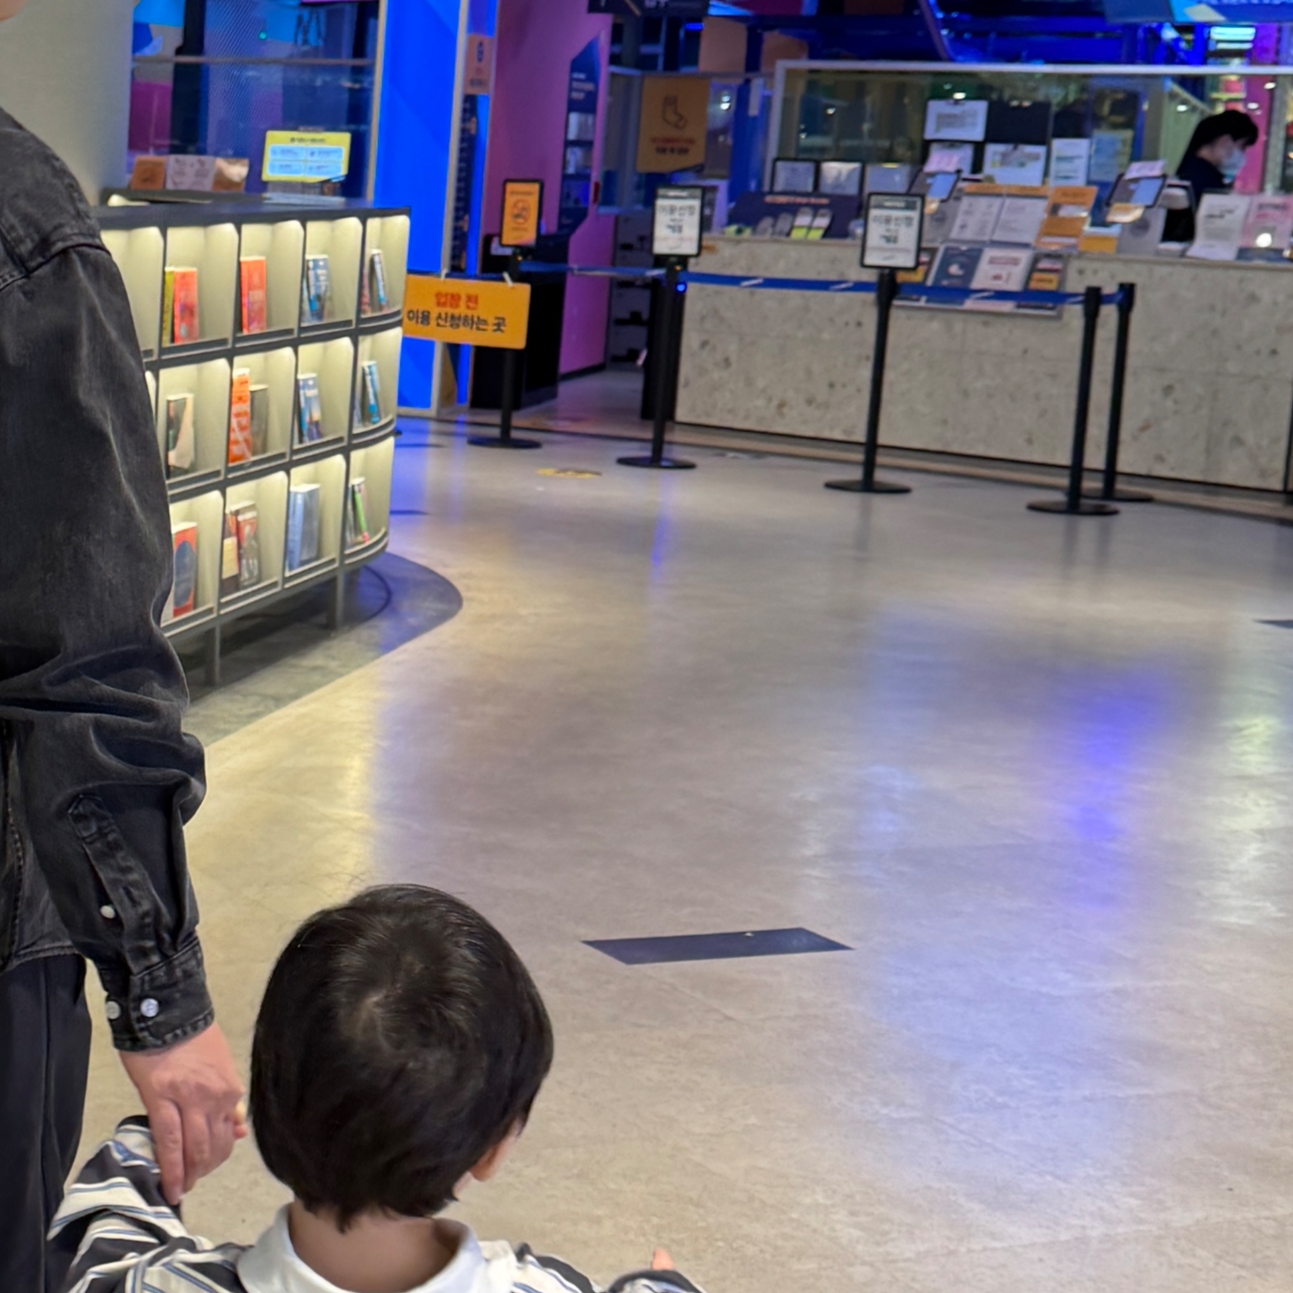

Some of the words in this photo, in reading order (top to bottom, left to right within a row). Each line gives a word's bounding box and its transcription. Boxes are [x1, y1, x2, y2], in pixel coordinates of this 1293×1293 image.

[407, 309, 431, 326] 이용
[435, 311, 489, 332] 신청하는
[492, 316, 506, 333] 곳
